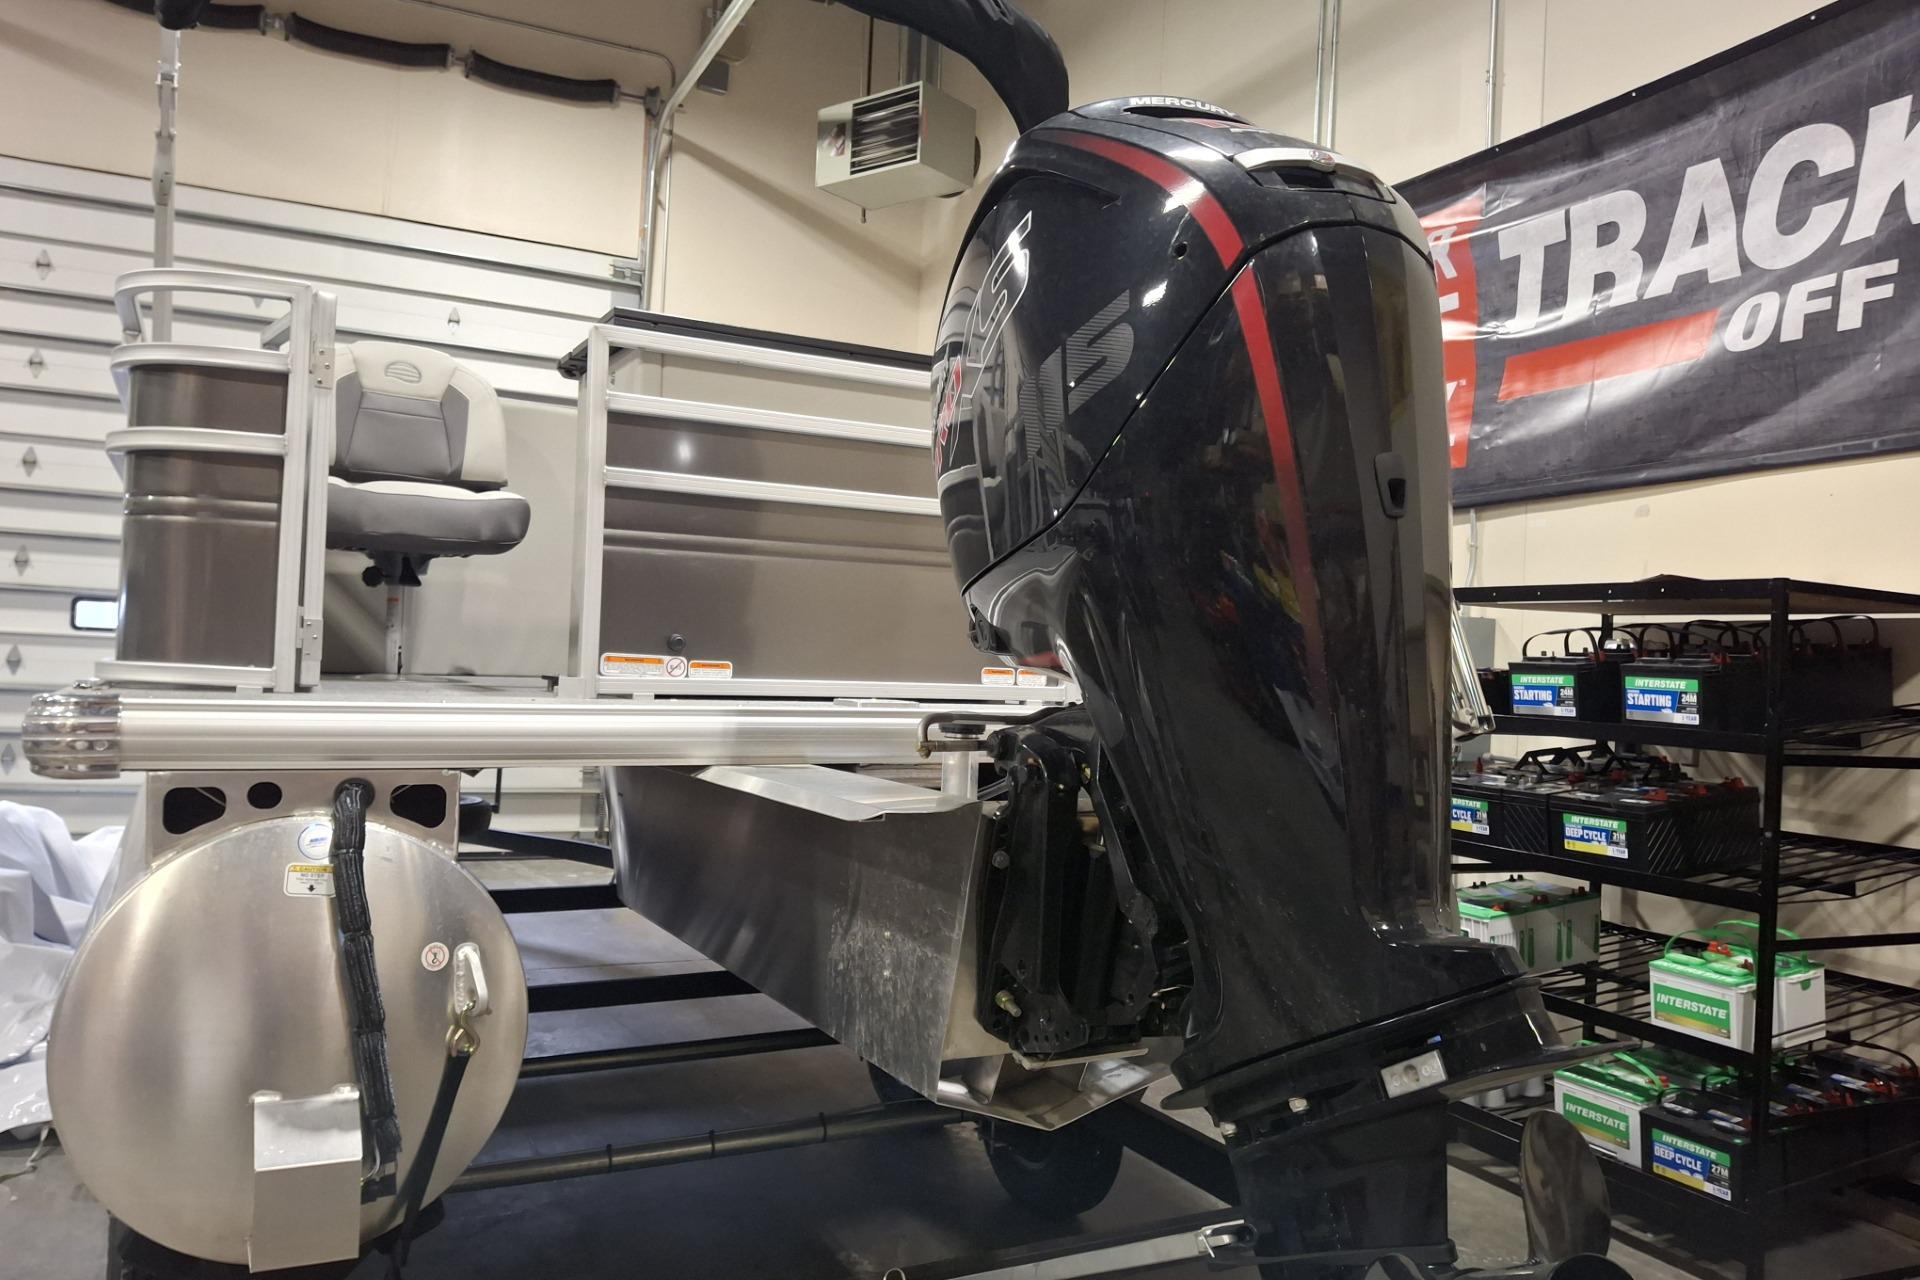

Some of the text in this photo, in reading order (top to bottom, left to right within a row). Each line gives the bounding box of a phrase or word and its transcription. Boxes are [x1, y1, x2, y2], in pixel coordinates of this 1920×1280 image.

[1128, 96, 1236, 118] MERCURY
[1723, 258, 1900, 353] OFF
[1520, 675, 1565, 685] INTERSTATE
[1634, 679, 1687, 689] INTERSTATE
[1513, 689, 1553, 701] STARTING
[1626, 693, 1672, 708] STARTING
[1452, 808, 1472, 820] CYCLE
[1571, 815, 1619, 829] INTERSTATE
[1565, 827, 1607, 842] DEEP CYCLE
[1656, 992, 1728, 1020] INTERSTATE
[1565, 1102, 1627, 1132] INTERSTATE
[1662, 1134, 1718, 1160] INTERSTATE
[1654, 1144, 1675, 1161] DEEP
[1675, 1153, 1703, 1172] CYCLE
[1711, 1163, 1729, 1178] 27M
